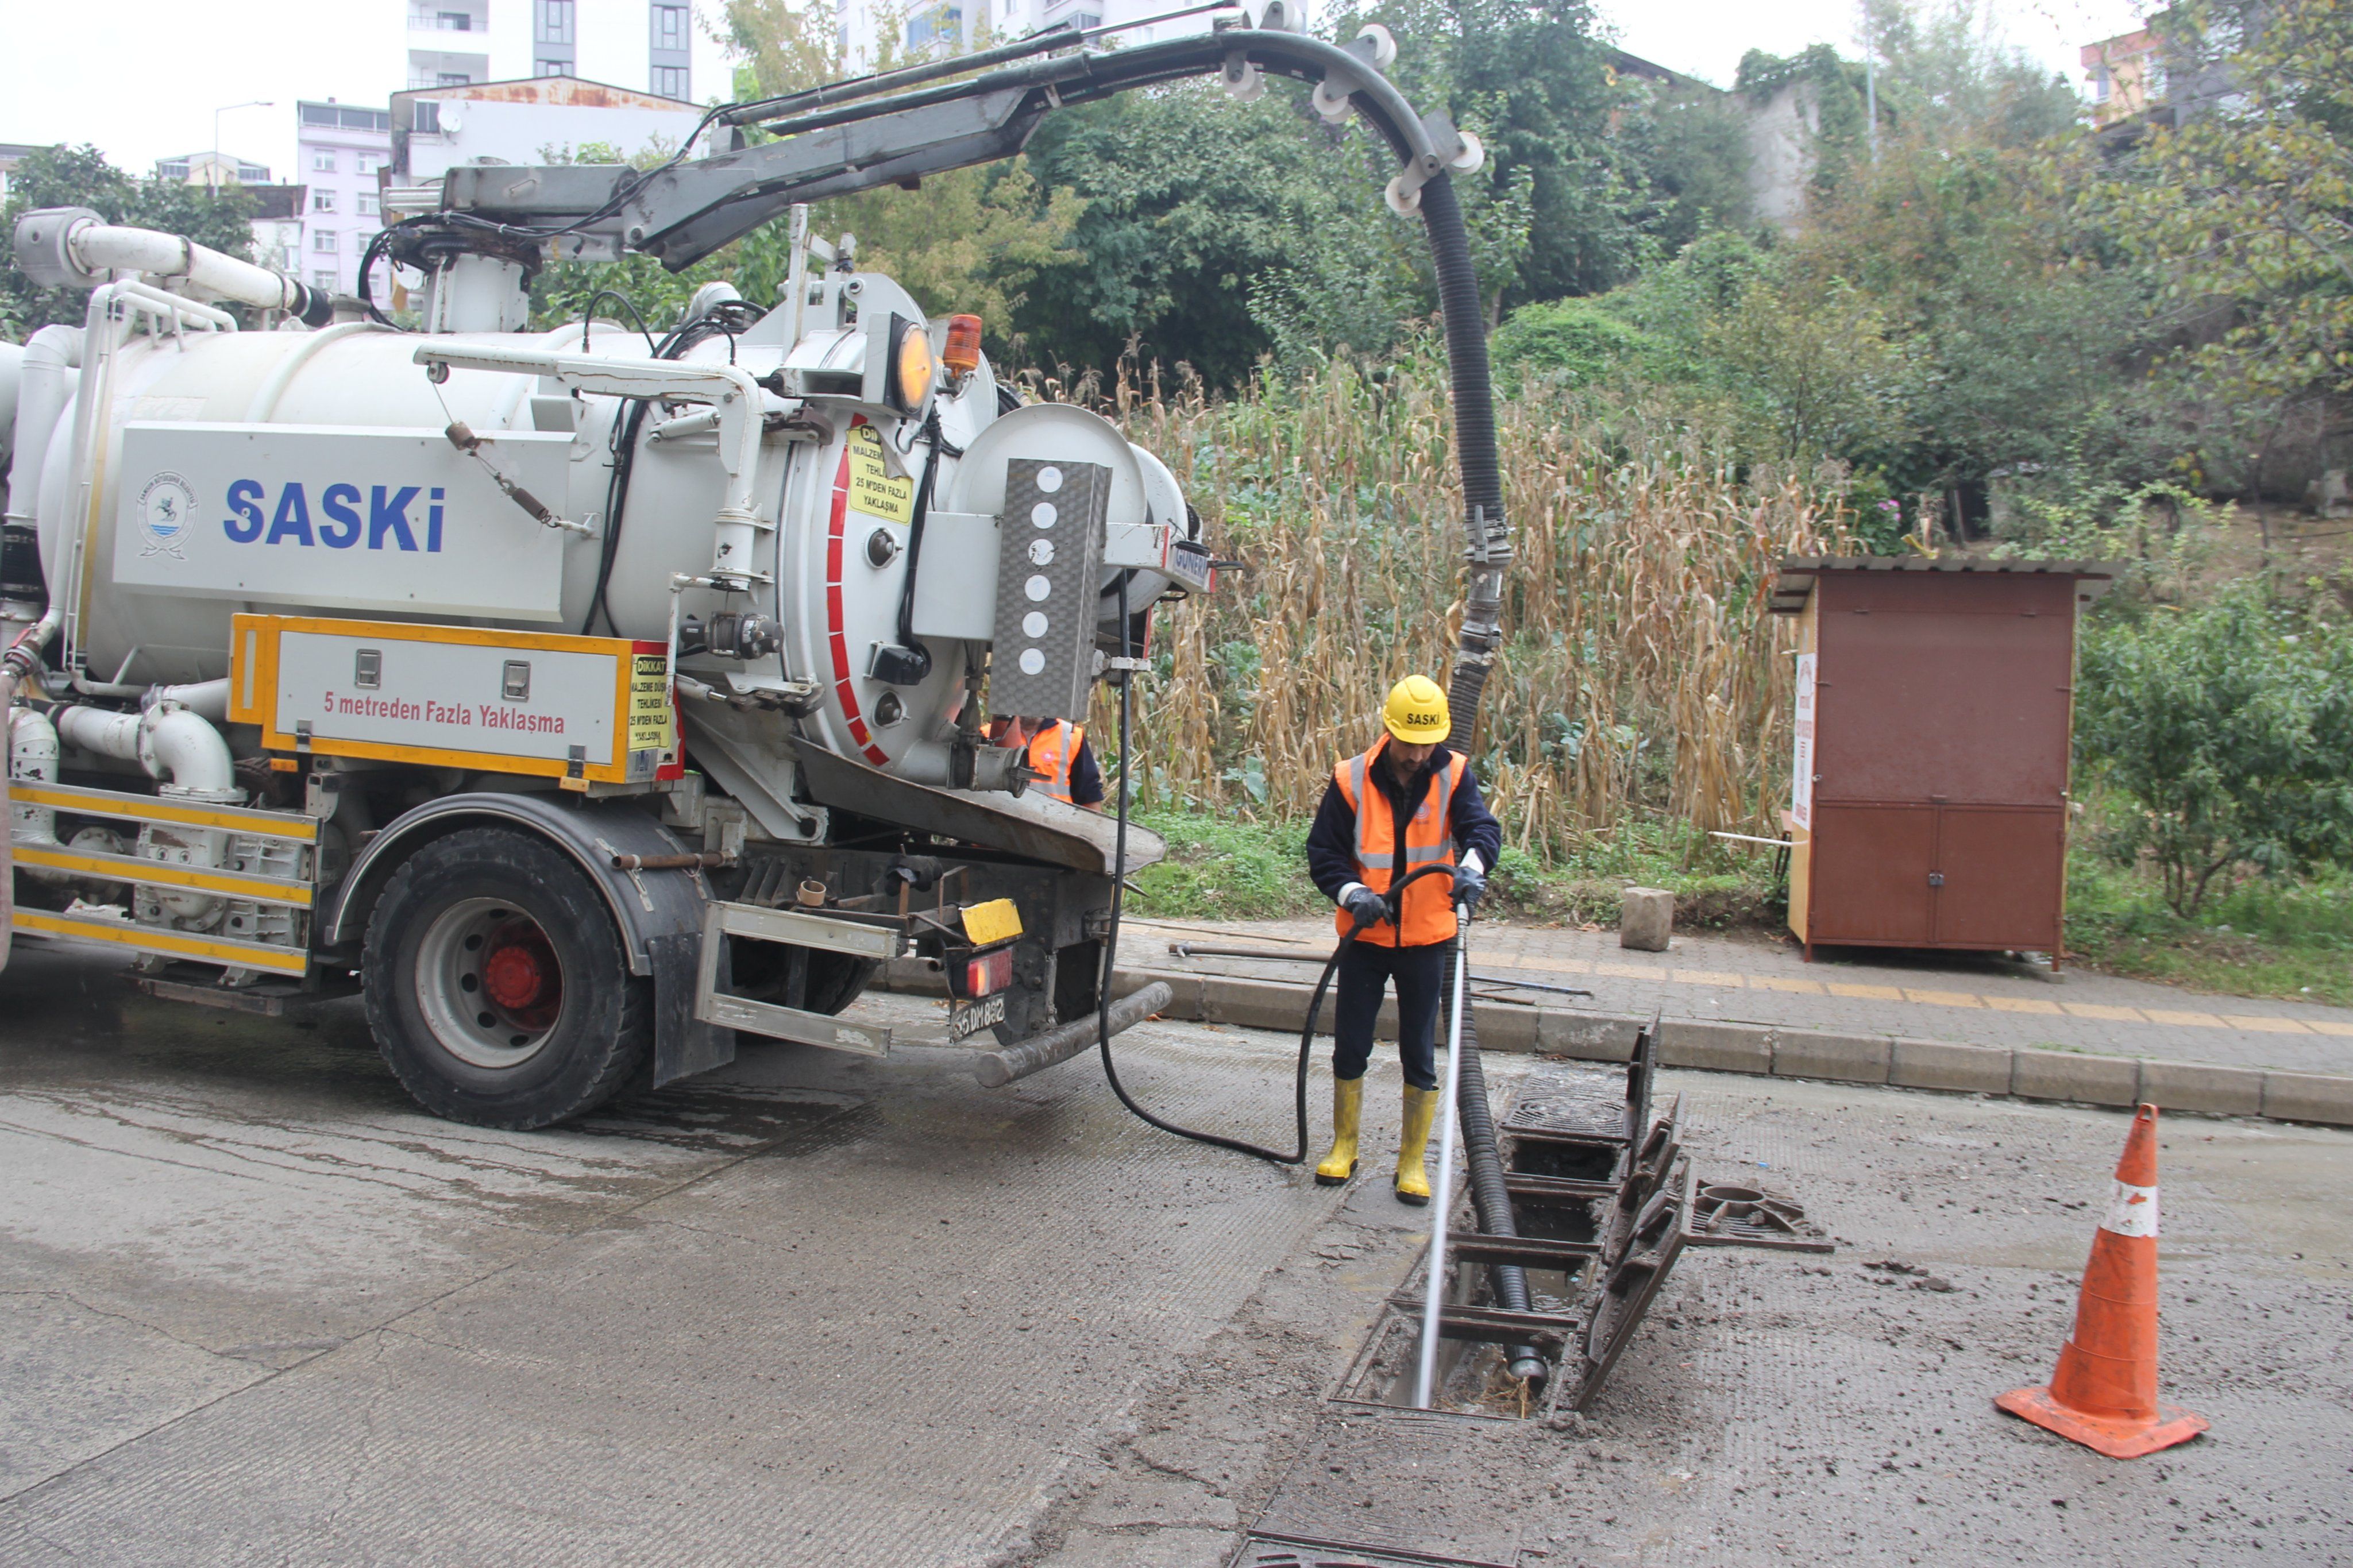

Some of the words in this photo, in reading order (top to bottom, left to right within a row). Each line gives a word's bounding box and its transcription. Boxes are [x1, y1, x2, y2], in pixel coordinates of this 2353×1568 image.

[856, 477, 865, 488] 25
[888, 486, 908, 500] FAZLA
[863, 495, 899, 513] YAKLAŞMA
[325, 691, 334, 712] 5
[339, 696, 421, 721] metreden
[426, 700, 471, 725] Fazla
[479, 705, 565, 734] Yaklaşma
[630, 715, 636, 725] 25
[653, 715, 668, 725] FAZLA
